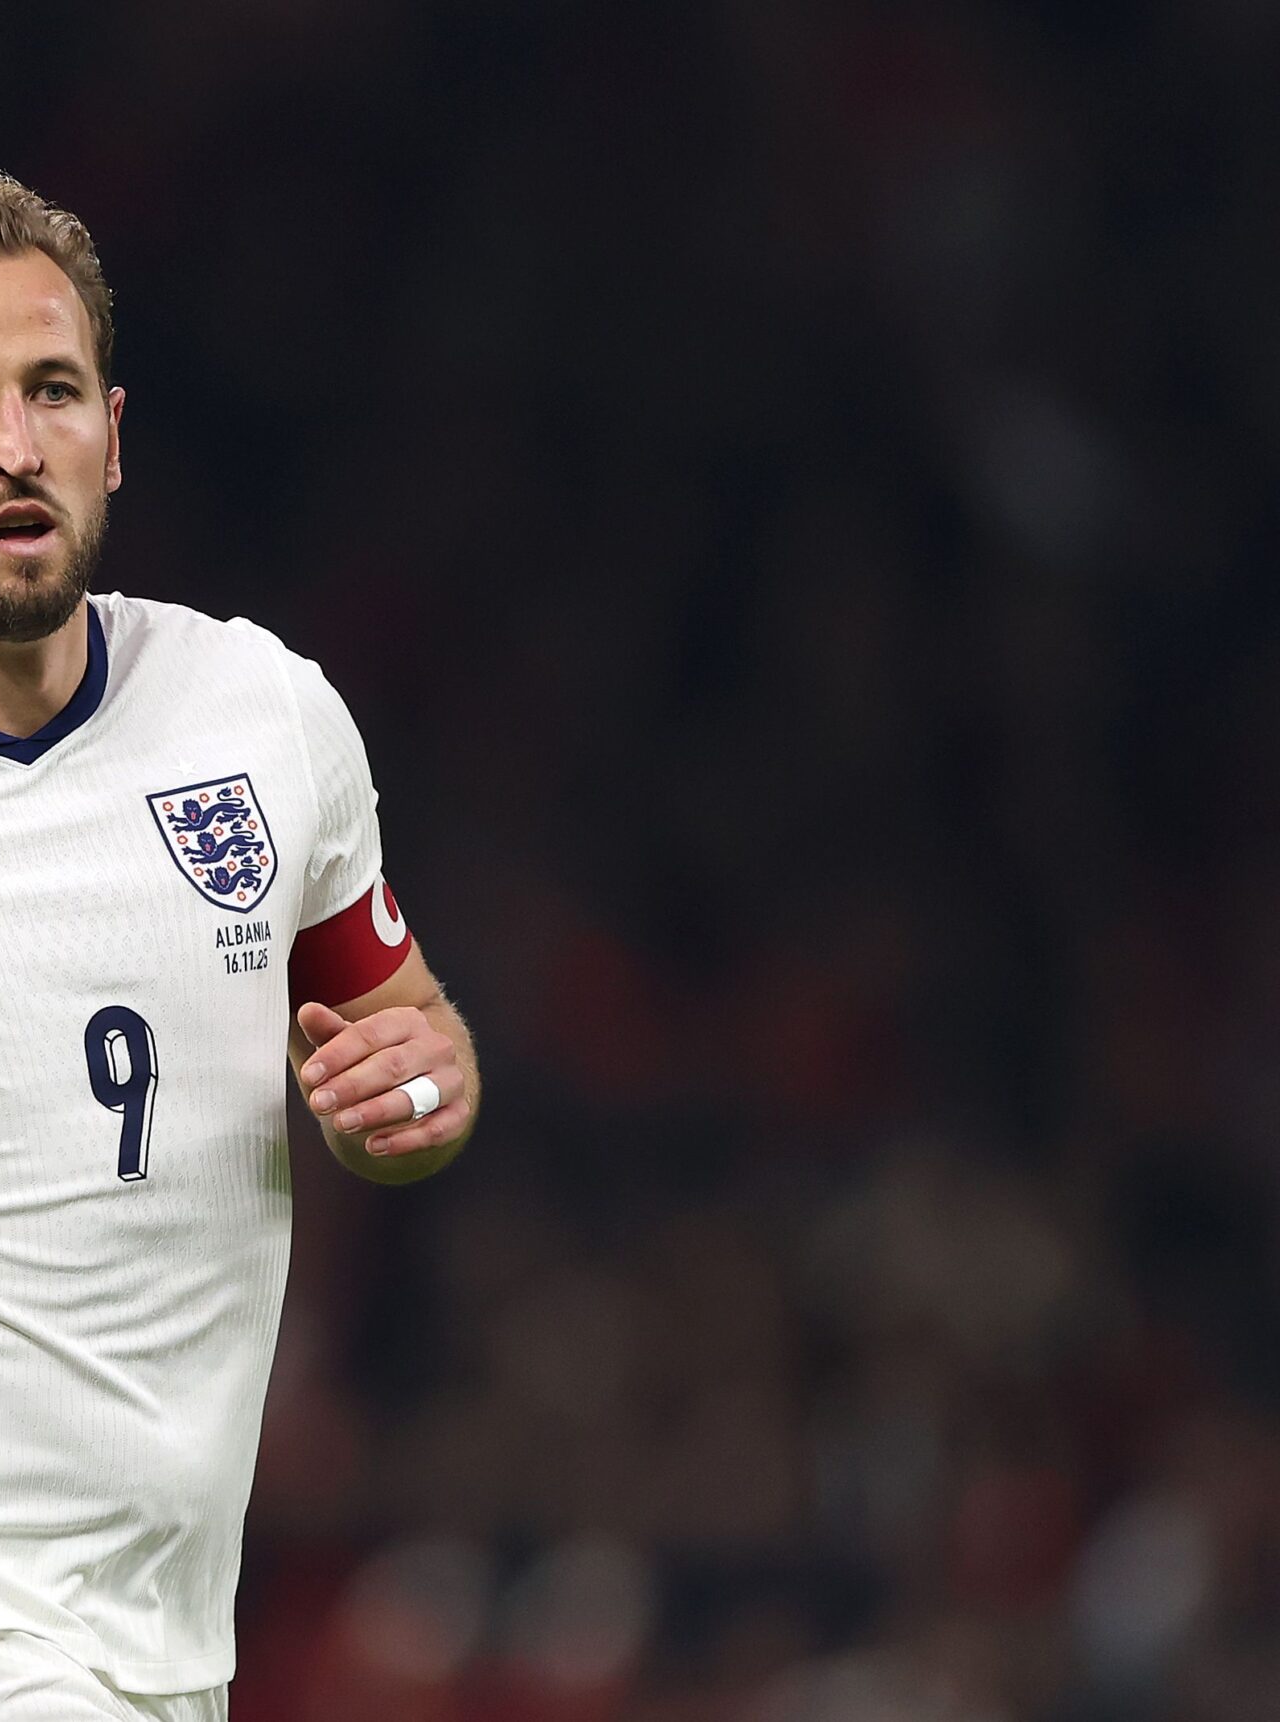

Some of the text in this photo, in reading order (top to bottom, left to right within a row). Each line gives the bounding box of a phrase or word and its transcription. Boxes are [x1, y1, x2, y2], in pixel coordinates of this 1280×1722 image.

[216, 920, 272, 948] ALBANIA
[224, 948, 268, 974] 16.11.25
[85, 1005, 159, 1182] 9
